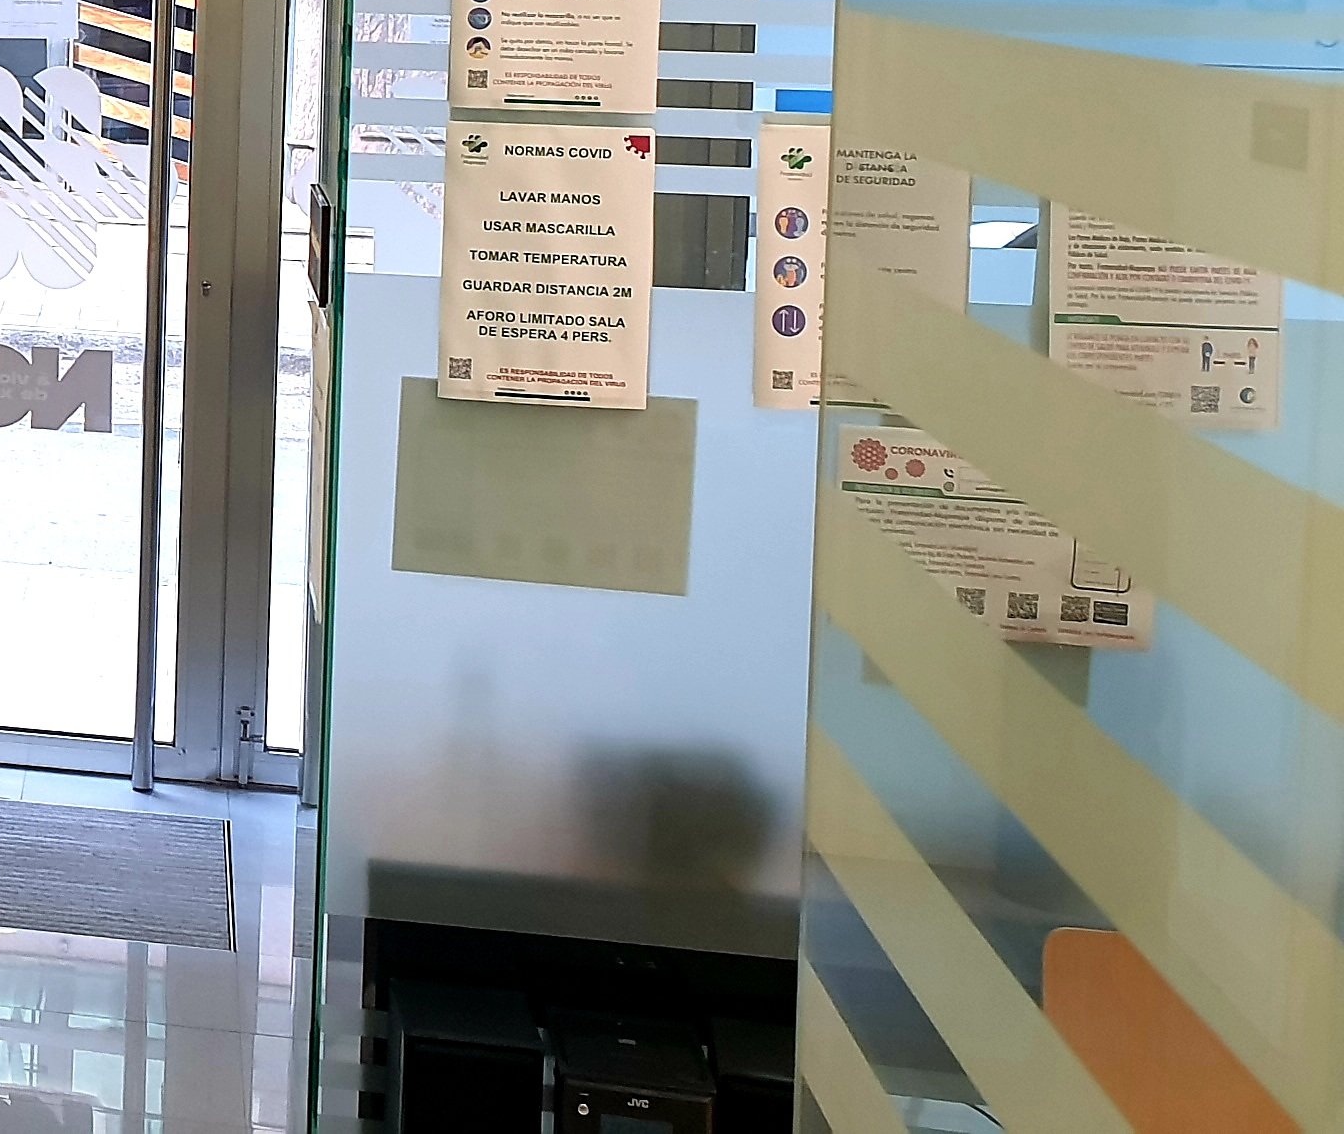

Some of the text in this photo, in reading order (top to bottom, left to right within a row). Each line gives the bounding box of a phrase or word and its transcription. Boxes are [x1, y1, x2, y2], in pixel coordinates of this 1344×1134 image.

[504, 145, 612, 159] NORMAS COVID
[836, 149, 917, 161] MANTENGA LA
[836, 175, 916, 187] DE SEGURIDAD
[500, 191, 601, 205] LAVAR MANOS
[483, 221, 615, 236] USAR MASCARILLA
[469, 250, 627, 267] TOMAR TEMPERATURA
[463, 280, 632, 298] GUARDAR DISTANCIA 2M
[466, 310, 625, 328] AFORO LIMITADO SALA
[479, 326, 612, 343] DE ESPERA 4 PERS.
[627, 1098, 649, 1109] JVC
